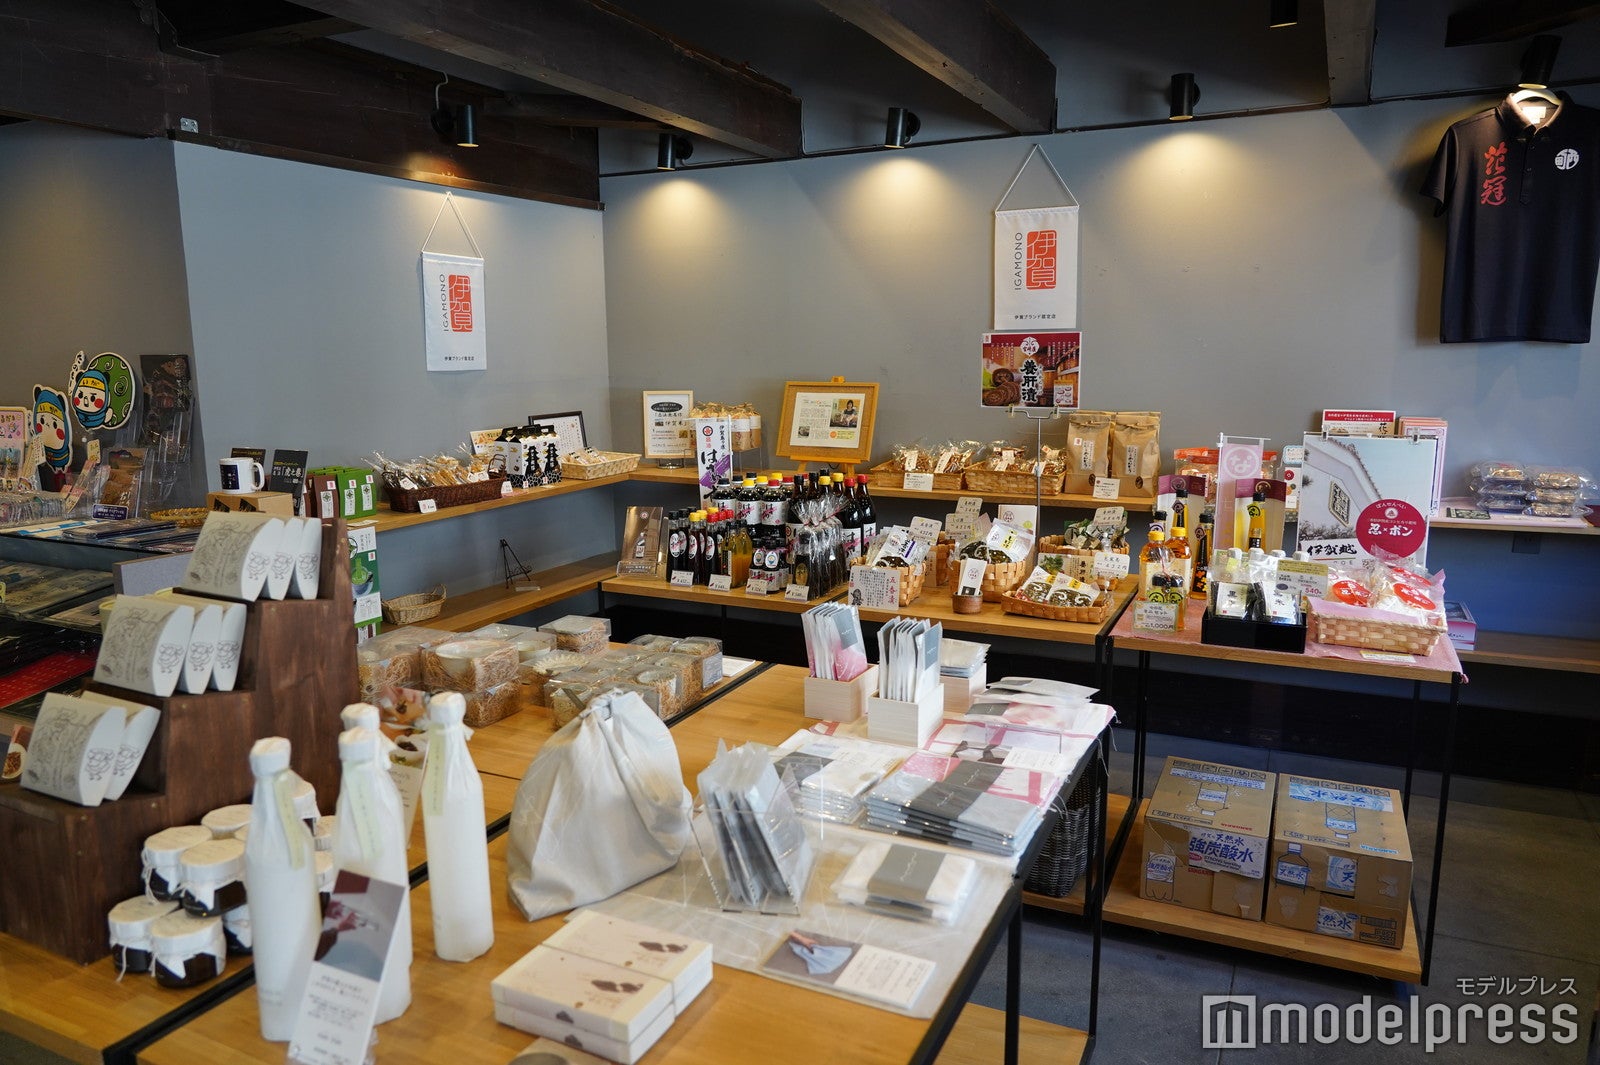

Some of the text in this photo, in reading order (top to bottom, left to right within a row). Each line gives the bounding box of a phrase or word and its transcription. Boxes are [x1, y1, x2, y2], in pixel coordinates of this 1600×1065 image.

[1015, 232, 1023, 290] IGAMONO
[1026, 230, 1057, 290] 伊賀
[439, 274, 449, 332] IGAMONO
[1020, 359, 1038, 402] 養肝漬
[1307, 543, 1358, 556] 伊賀越
[889, 576, 897, 604] 五香漬
[1189, 836, 1254, 863] 強炭酸水
